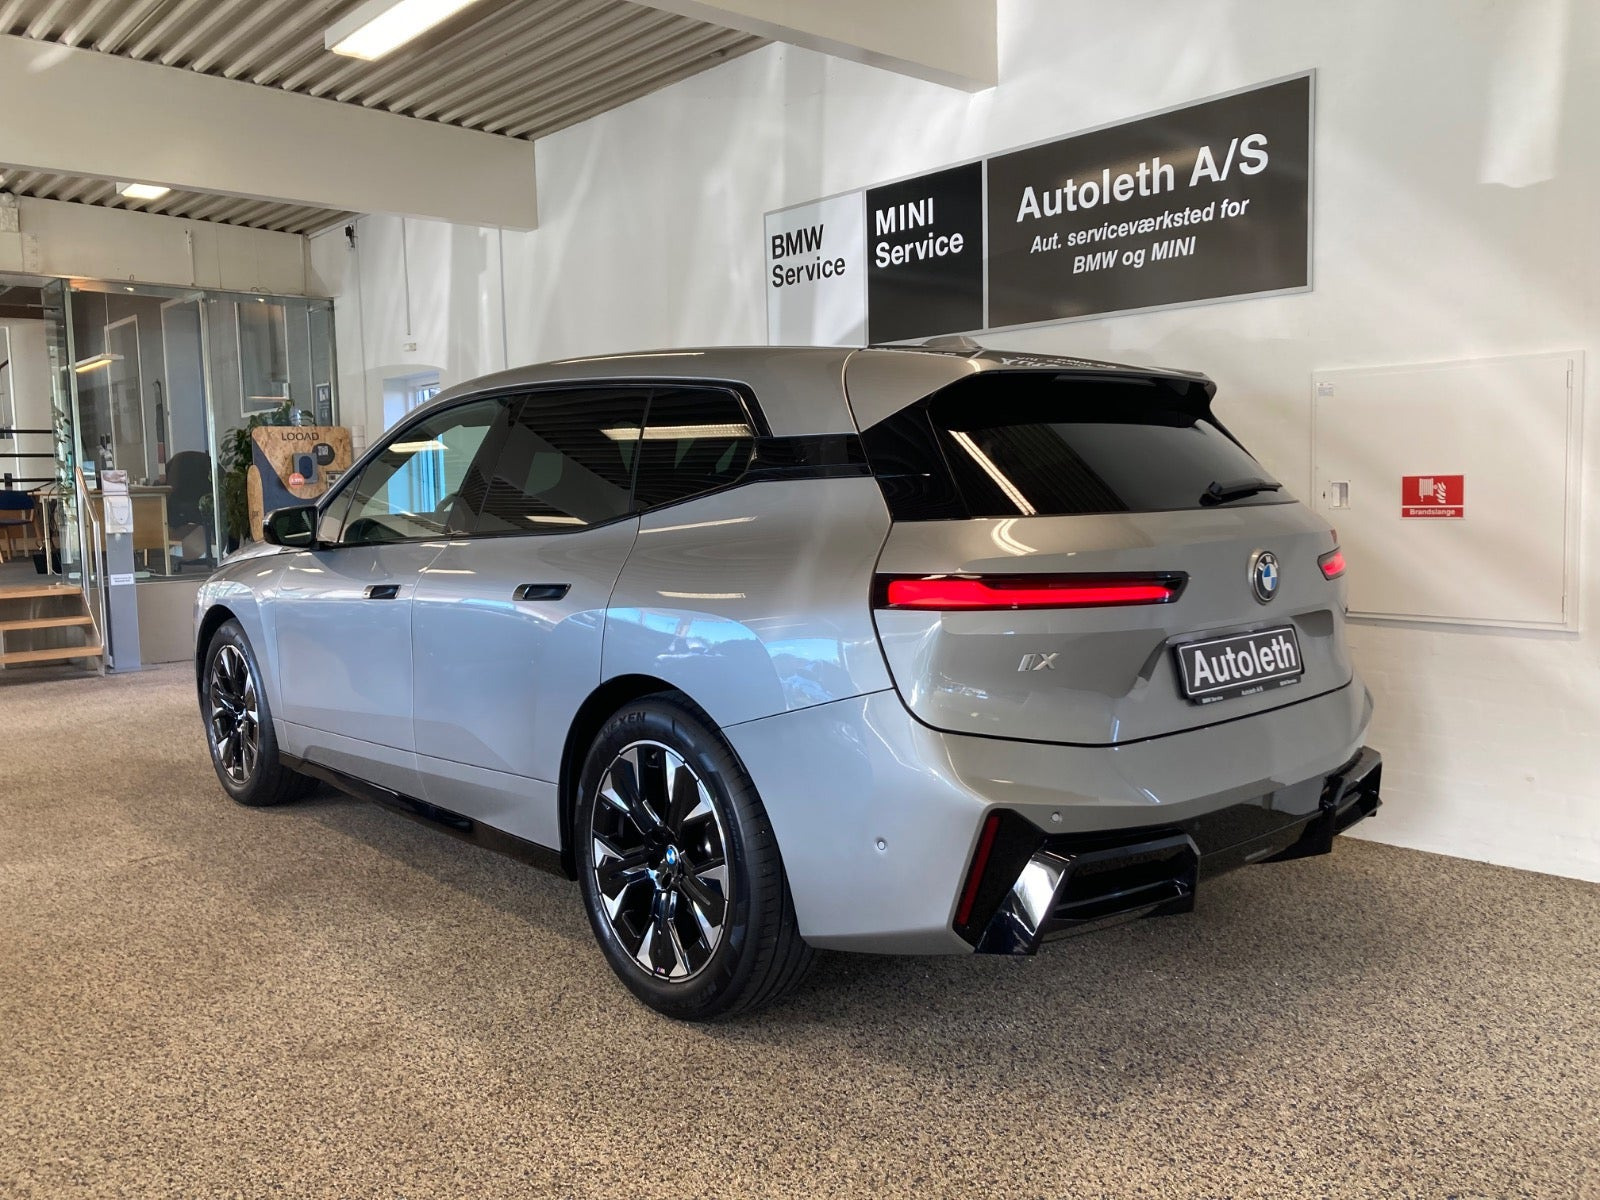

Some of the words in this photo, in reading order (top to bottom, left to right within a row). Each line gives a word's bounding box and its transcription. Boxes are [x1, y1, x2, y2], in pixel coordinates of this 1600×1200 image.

[1016, 157, 1175, 223] Autoleth
[1189, 133, 1269, 187] A/S
[875, 197, 934, 236] MINI
[1030, 235, 1062, 254] Aut.
[1067, 202, 1215, 248] serviceværksted
[1220, 198, 1250, 219] for
[772, 224, 824, 260] BMW
[875, 232, 964, 268] Service
[1072, 249, 1118, 274] BMW
[1122, 249, 1146, 269] og
[1151, 236, 1196, 262] MINI
[772, 256, 846, 288] Service
[1409, 508, 1456, 517] Brandslange
[1193, 635, 1298, 687] Autoleth
